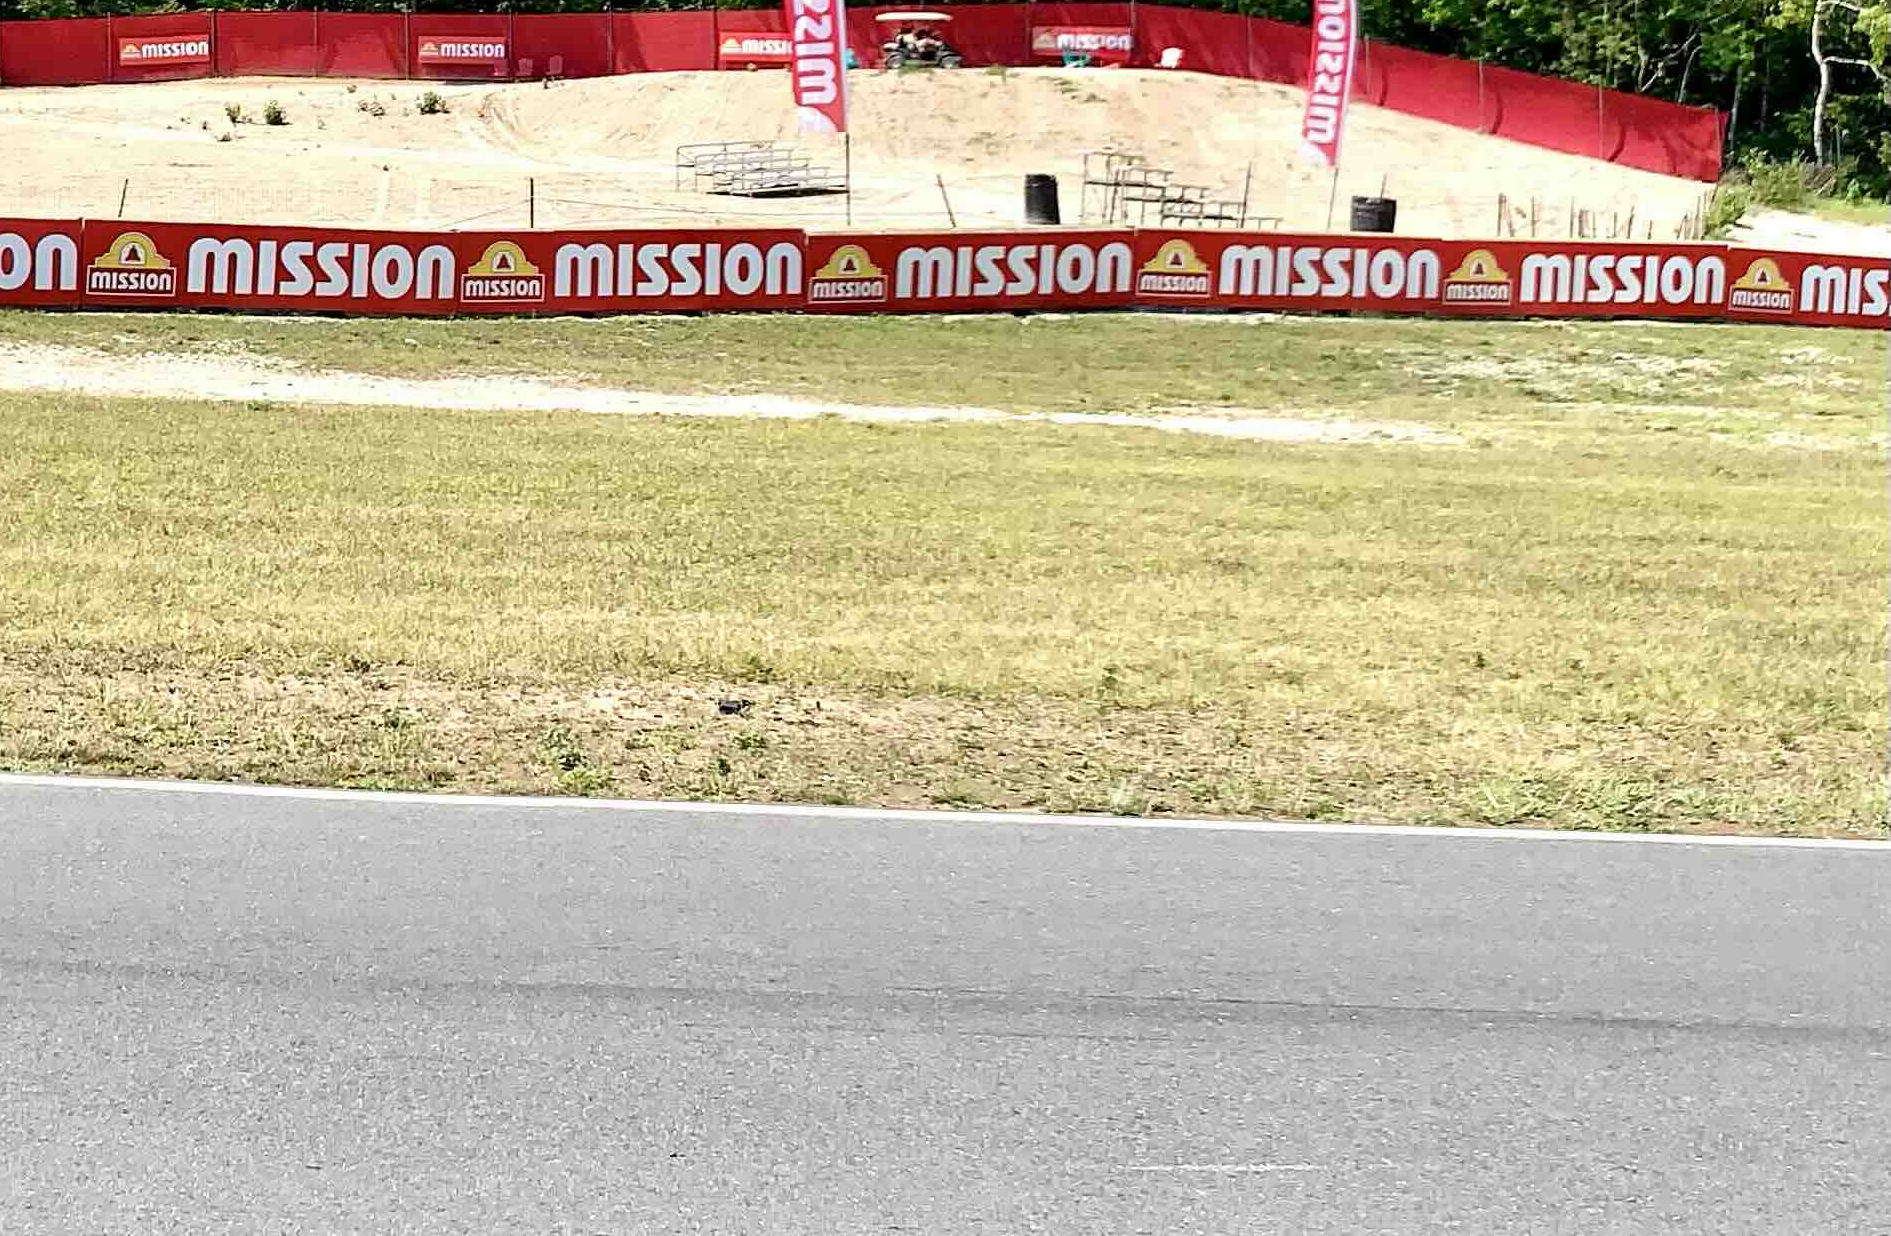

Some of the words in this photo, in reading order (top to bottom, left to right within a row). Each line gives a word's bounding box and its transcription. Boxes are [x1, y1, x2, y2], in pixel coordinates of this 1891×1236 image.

[141, 40, 208, 59] MISSION
[441, 43, 506, 58] MISSION
[187, 237, 455, 300] MISSION
[554, 243, 802, 297] MISSION
[896, 243, 1128, 297] MISSION
[1219, 245, 1438, 299] MISSION
[89, 271, 173, 291] MISSION
[465, 278, 541, 297] MISSION
[1139, 275, 1208, 293] MISSION
[1521, 254, 1725, 305] MISSION
[811, 281, 885, 301] MISSION
[1446, 283, 1509, 300] MISSION
[1732, 290, 1790, 307] MISSION
[1799, 264, 1891, 317] MIS
